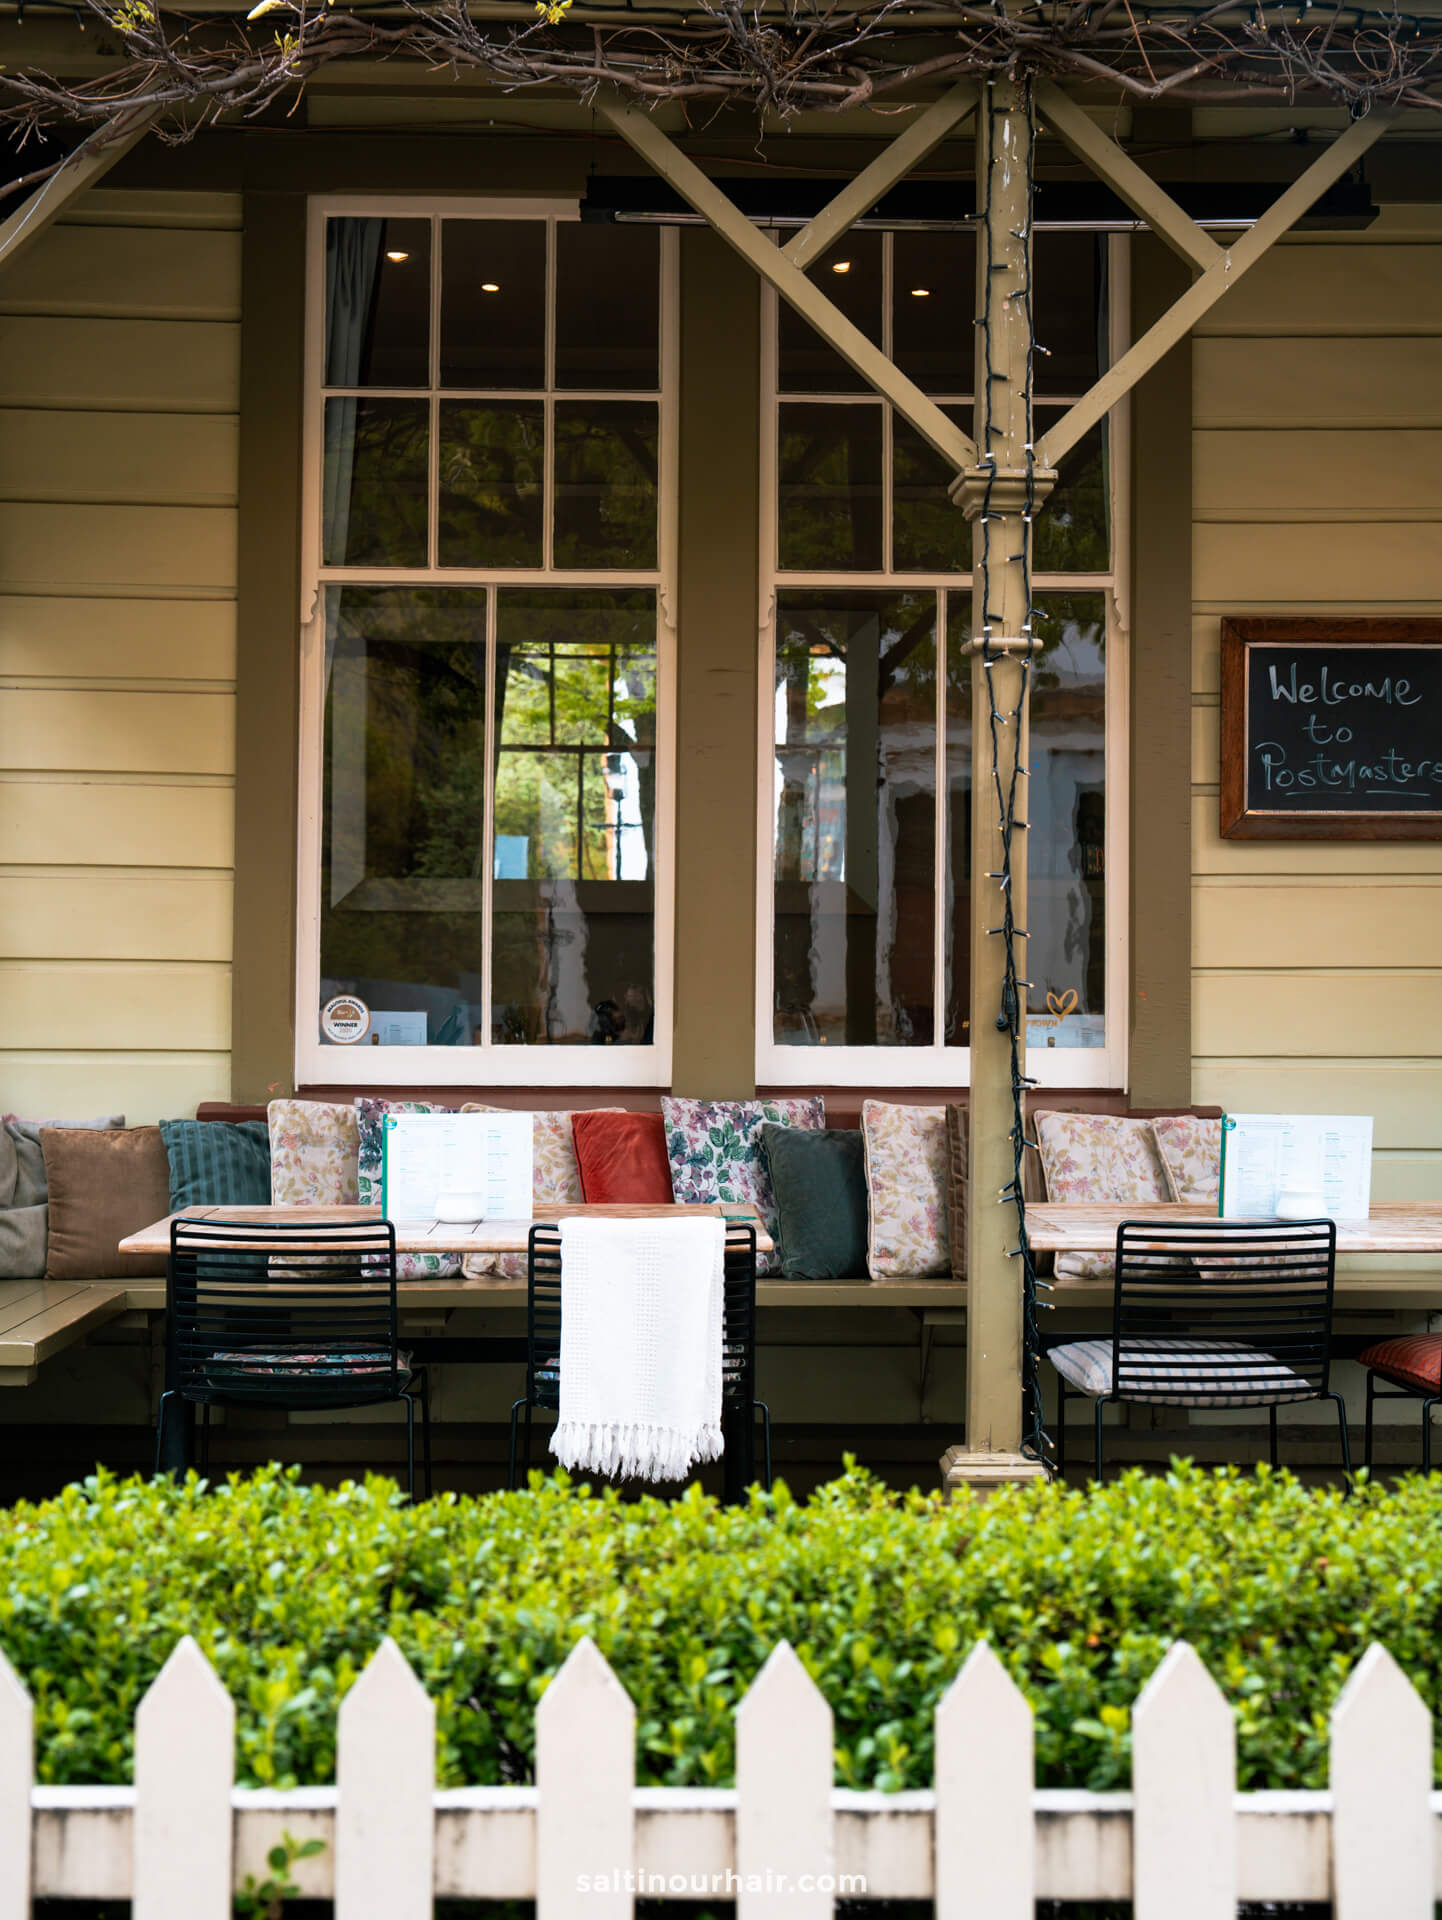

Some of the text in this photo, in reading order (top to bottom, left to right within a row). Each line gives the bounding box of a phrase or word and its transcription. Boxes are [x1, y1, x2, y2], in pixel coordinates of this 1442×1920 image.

[1268, 662, 1422, 705] Welcome
[1302, 713, 1352, 744] to
[1255, 741, 1442, 790] Postmasters
